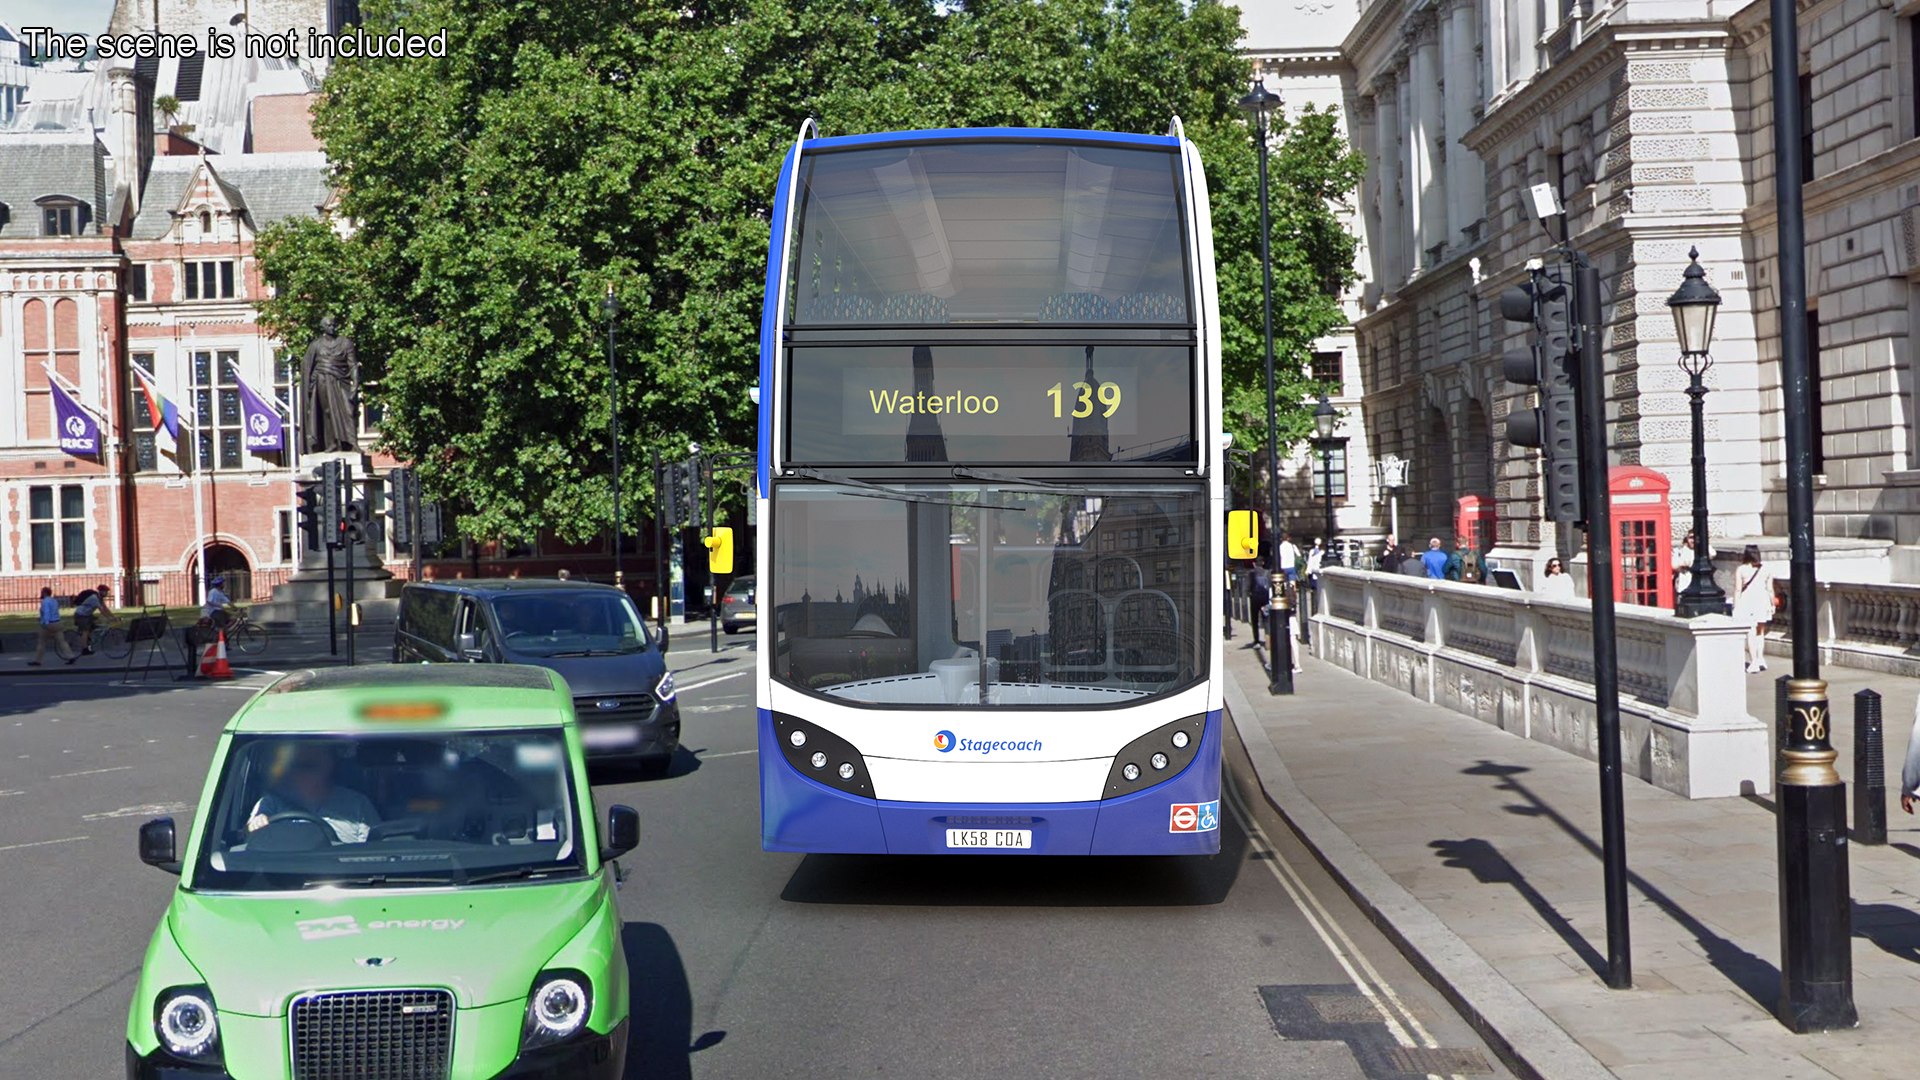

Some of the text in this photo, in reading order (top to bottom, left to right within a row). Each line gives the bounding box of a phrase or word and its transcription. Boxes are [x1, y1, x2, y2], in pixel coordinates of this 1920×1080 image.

[869, 389, 999, 416] Waterloo
[1046, 382, 1121, 419] 139
[959, 737, 1043, 755] Stagecoach
[952, 831, 1023, 847] LK58 COA
[367, 918, 466, 931] energy
